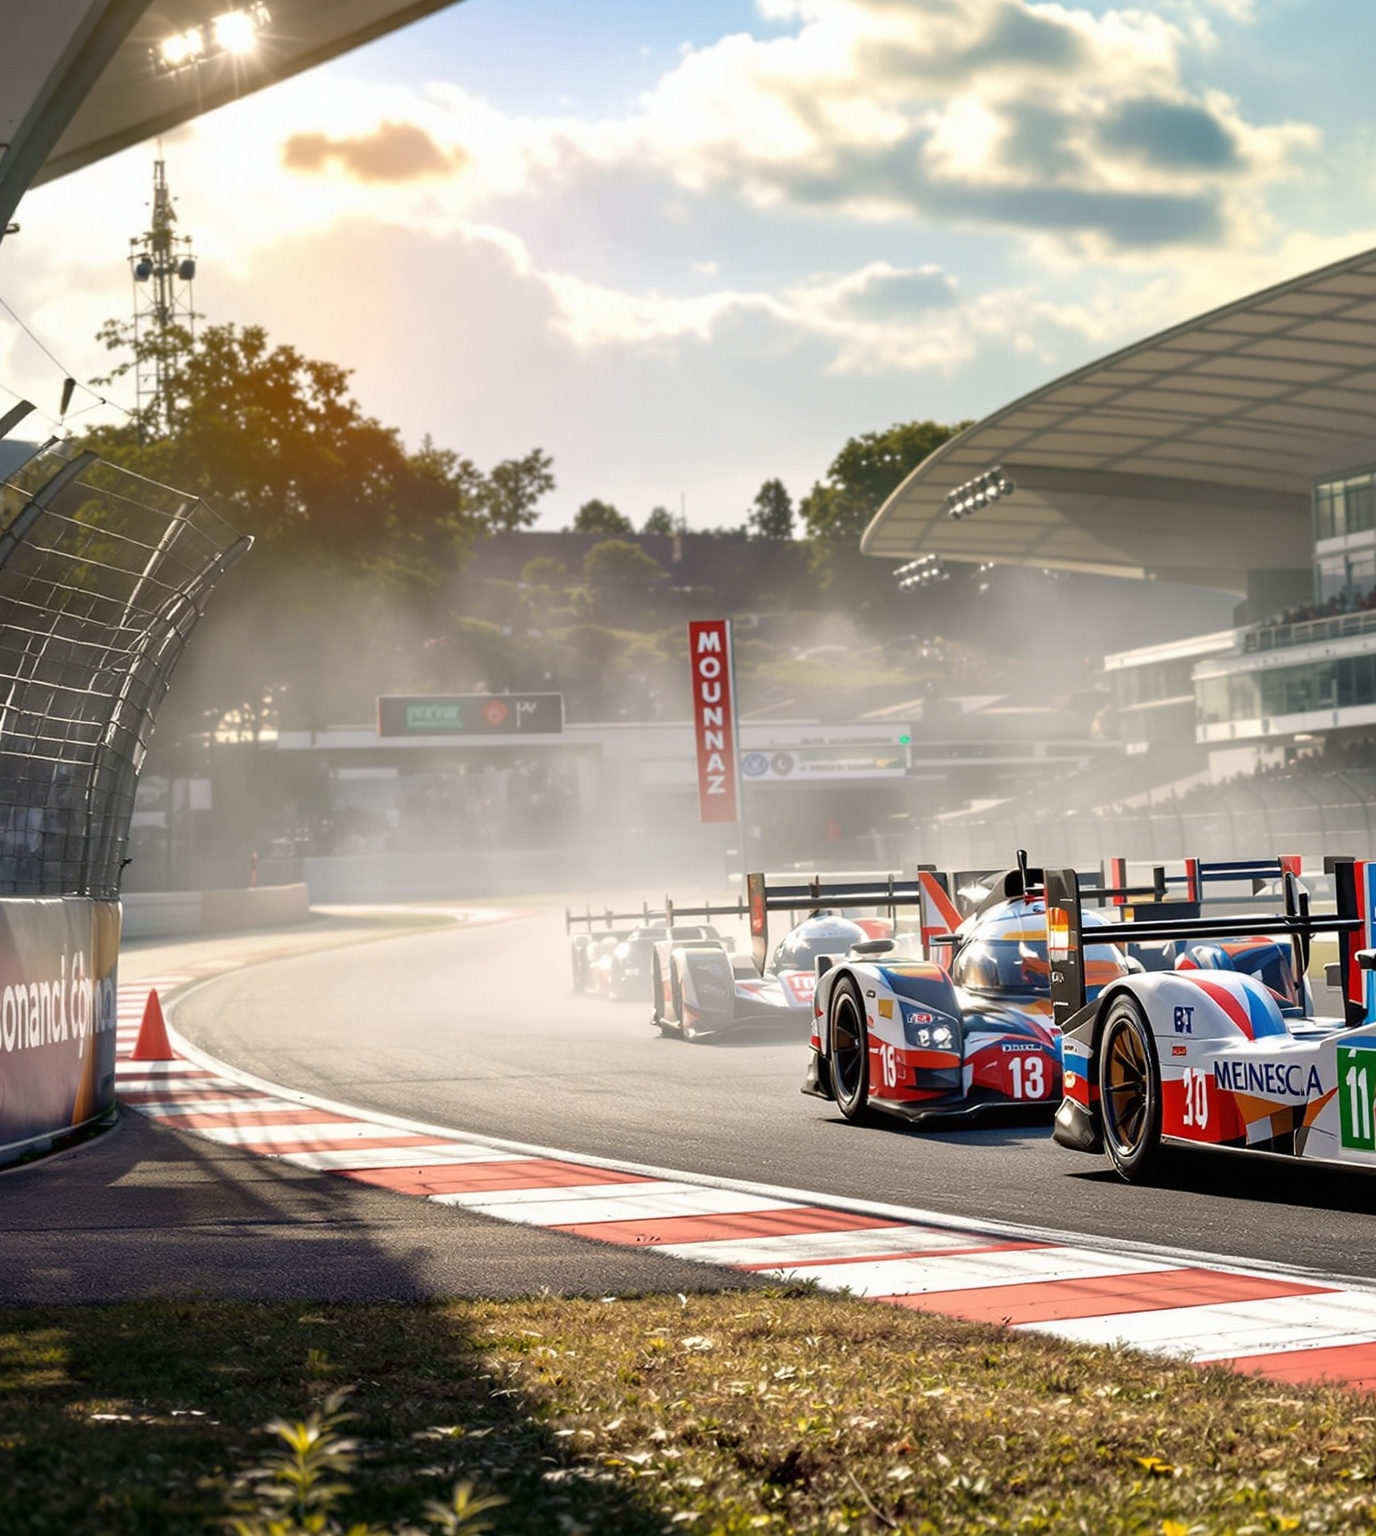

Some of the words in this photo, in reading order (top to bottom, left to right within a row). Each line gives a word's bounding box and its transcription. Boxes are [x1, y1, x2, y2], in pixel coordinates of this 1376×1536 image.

[698, 631, 726, 794] MOUNNAZ
[1008, 1056, 1044, 1099] 13
[1345, 1066, 1371, 1140] 11
